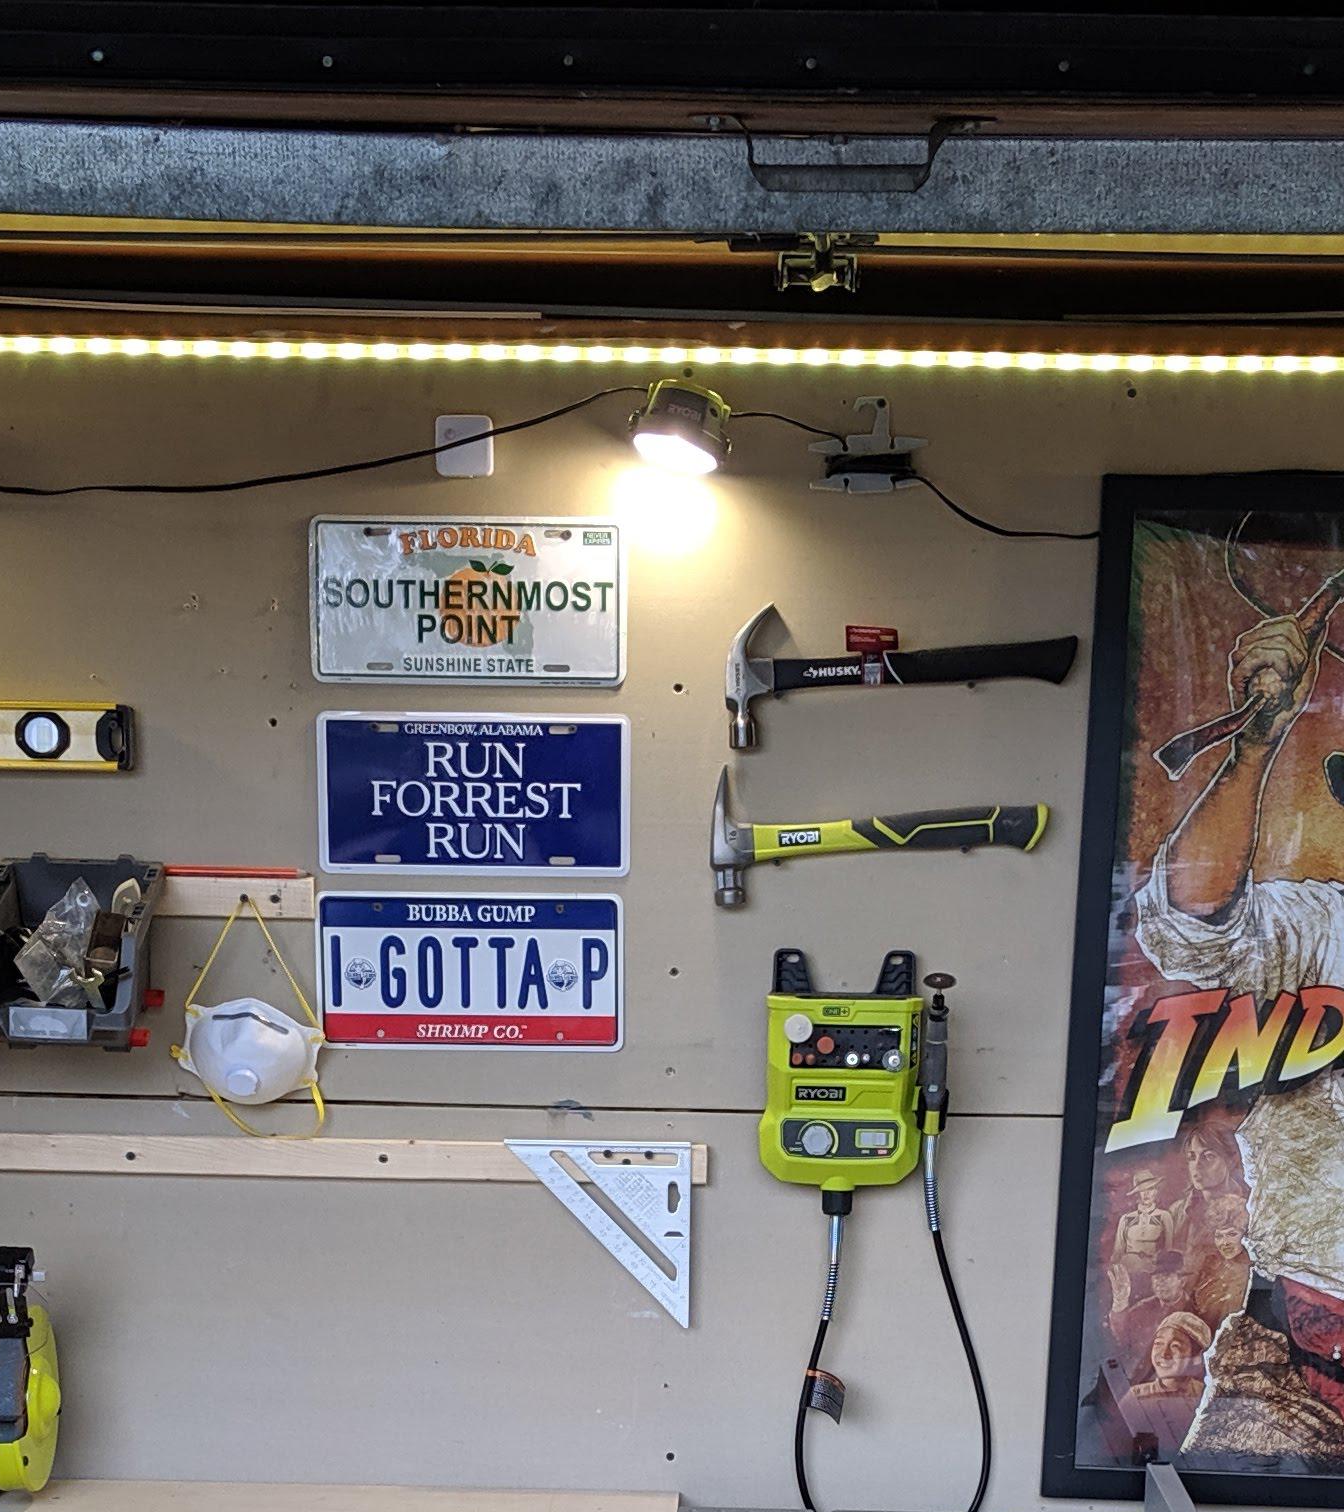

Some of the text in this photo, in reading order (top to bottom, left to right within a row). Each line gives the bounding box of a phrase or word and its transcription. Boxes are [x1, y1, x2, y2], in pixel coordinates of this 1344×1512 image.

[399, 526, 537, 556] FLORIDA
[322, 576, 614, 612] SOUTHERNMOST
[417, 613, 521, 644] POINT
[403, 657, 534, 673] SUNSHINE STATE
[818, 665, 861, 677] HUSKY
[424, 741, 525, 779] RUN
[370, 780, 582, 819] FORREST
[425, 821, 526, 860] RUN
[780, 830, 819, 846] RYOBI
[408, 905, 536, 923] BUBBA GUMP
[329, 934, 609, 1010] I GOTTA P
[417, 1024, 488, 1038] SHRIMP
[798, 1088, 843, 1099] RYOBI
